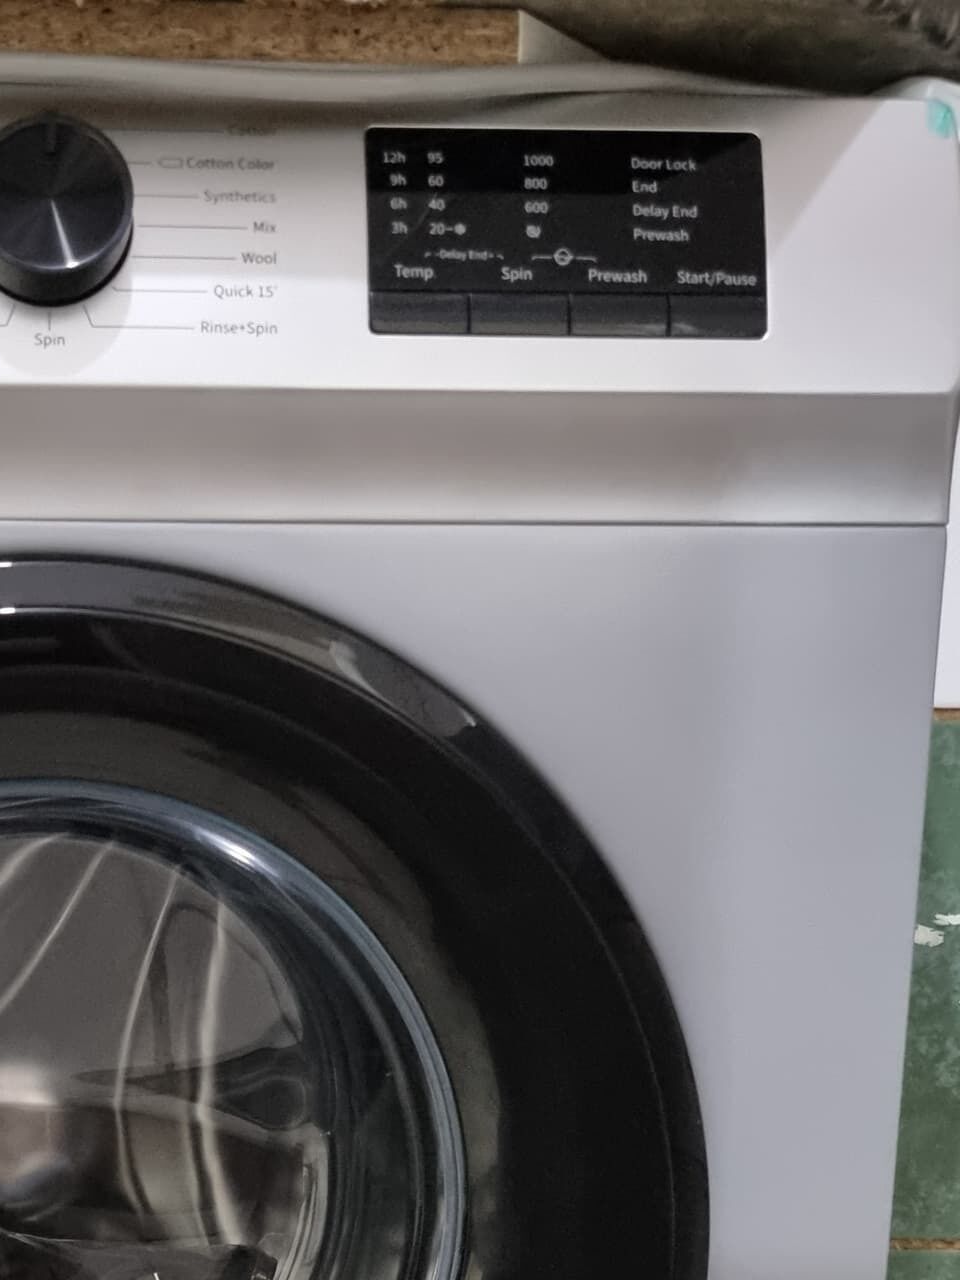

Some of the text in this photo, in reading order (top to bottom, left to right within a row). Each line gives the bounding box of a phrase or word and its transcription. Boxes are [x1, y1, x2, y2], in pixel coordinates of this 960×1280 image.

[186, 157, 276, 171] Cotton Color
[383, 152, 406, 164] 12h
[427, 152, 444, 164] 95
[523, 155, 554, 167] 1000
[631, 157, 697, 172] Door Lock
[390, 174, 407, 187] 9h
[428, 175, 444, 187] 60
[524, 177, 548, 190] 800
[632, 180, 657, 194] End
[203, 189, 276, 205] Synthetics
[428, 198, 446, 211] 40
[524, 201, 549, 214] 600
[632, 203, 698, 220] Delay End
[253, 221, 277, 233] Mix
[392, 222, 408, 234] 3h
[430, 223, 445, 235] 20
[633, 227, 689, 243] Prewash
[241, 251, 278, 265] Wool
[394, 264, 435, 281] Temp
[501, 266, 533, 282] Spin
[588, 268, 648, 284] Prewash
[677, 271, 758, 287] Start/Pause
[213, 284, 252, 300] Quick
[200, 320, 278, 337] Rinse+Spin
[34, 332, 66, 349] Spin
